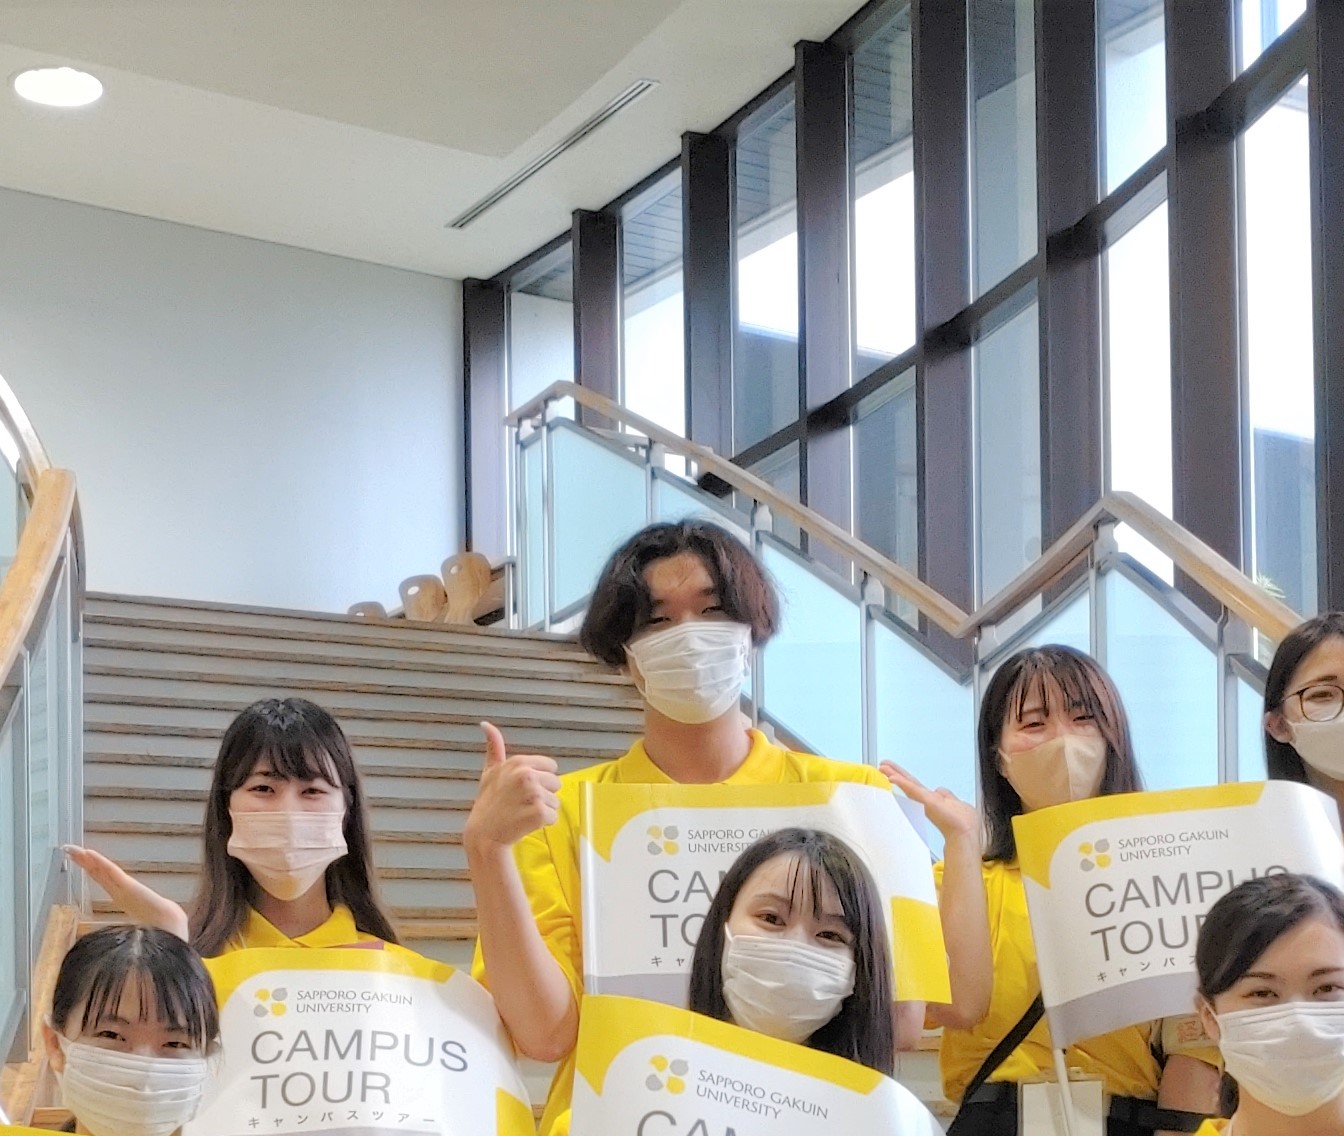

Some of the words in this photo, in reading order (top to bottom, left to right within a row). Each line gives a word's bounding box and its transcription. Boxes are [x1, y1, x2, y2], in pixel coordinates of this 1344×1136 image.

[687, 829, 745, 840] SAPPORO
[1118, 833, 1175, 849] SAPPORO
[1178, 828, 1230, 842] GAKUIN
[1119, 845, 1192, 862] UNIVERSITY
[296, 1002, 372, 1014] UNIVERSITY
[297, 990, 357, 1002] SAPPORO
[360, 992, 413, 1006] GAKUIN
[251, 1029, 469, 1073] CAMPUS
[250, 1071, 392, 1110] TOUR
[697, 1069, 767, 1099] SAPPORO
[770, 1091, 829, 1120] GAKUIN
[695, 1085, 782, 1120] UNIVERSITY
